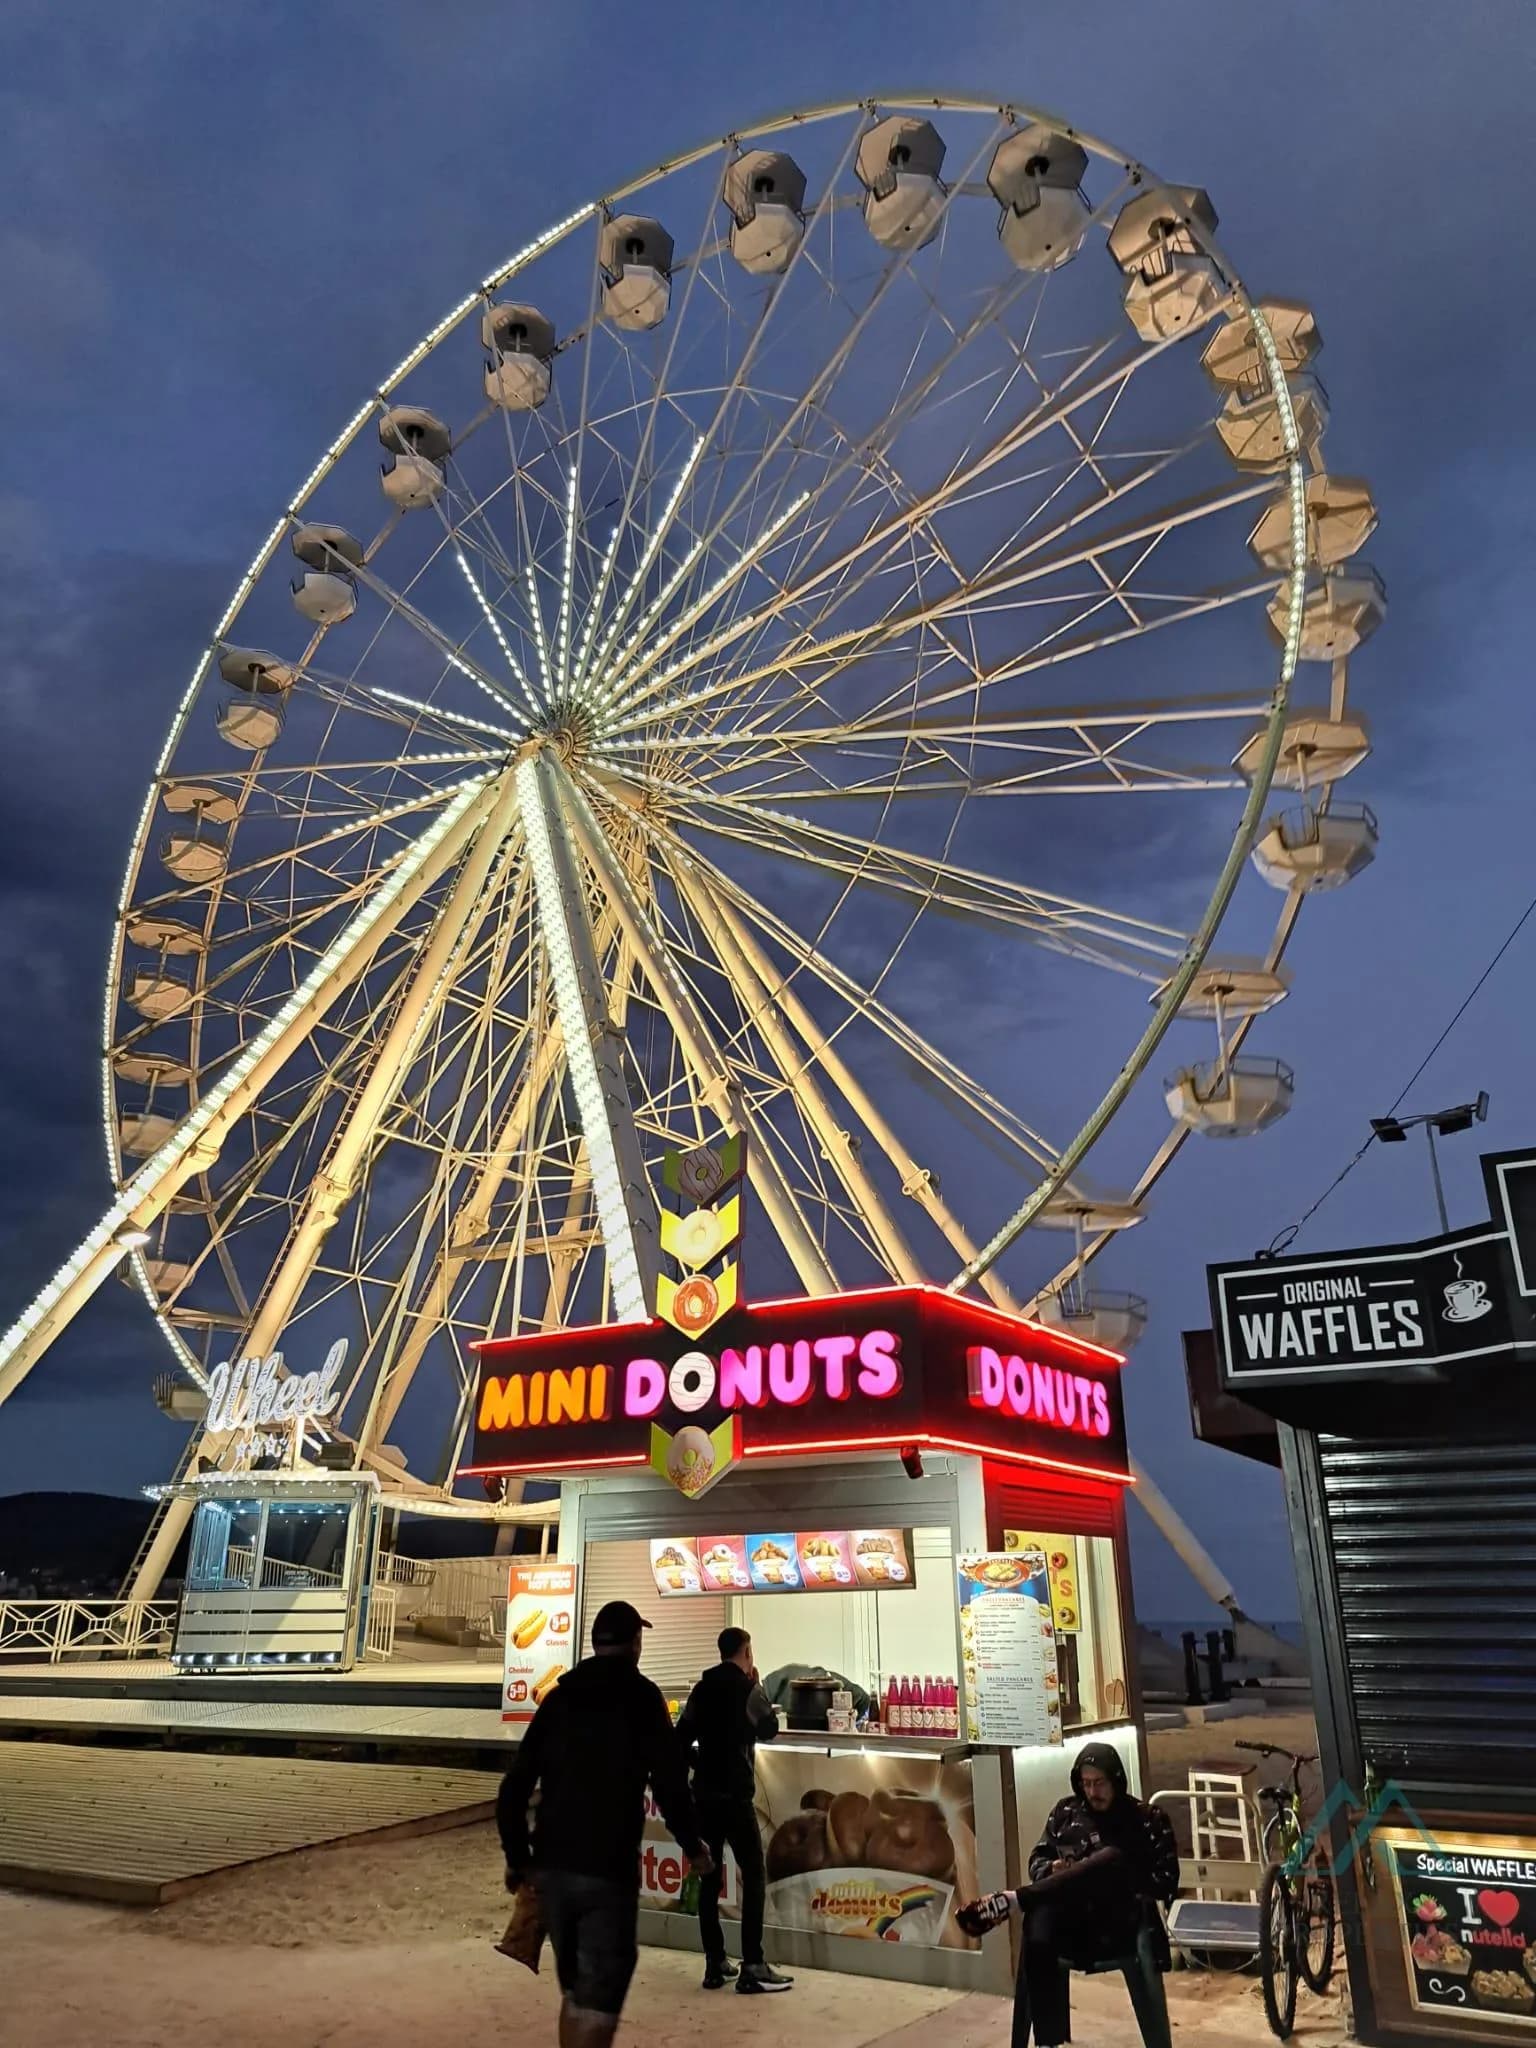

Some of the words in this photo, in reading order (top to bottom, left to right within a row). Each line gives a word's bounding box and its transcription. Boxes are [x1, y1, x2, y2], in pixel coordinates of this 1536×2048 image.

[1283, 1276, 1366, 1305] ORIGINAL
[1239, 1300, 1424, 1360] WAFFLES
[207, 1338, 349, 1433] Wheel
[478, 1364, 609, 1431] MINI
[624, 1330, 899, 1416] DONUTS
[977, 1345, 1111, 1437] DONUTS
[1417, 1853, 1469, 1875] Special
[1470, 1857, 1536, 1880] WAFFLE
[1456, 1887, 1482, 1925] I
[1461, 1927, 1527, 1949] nutella
